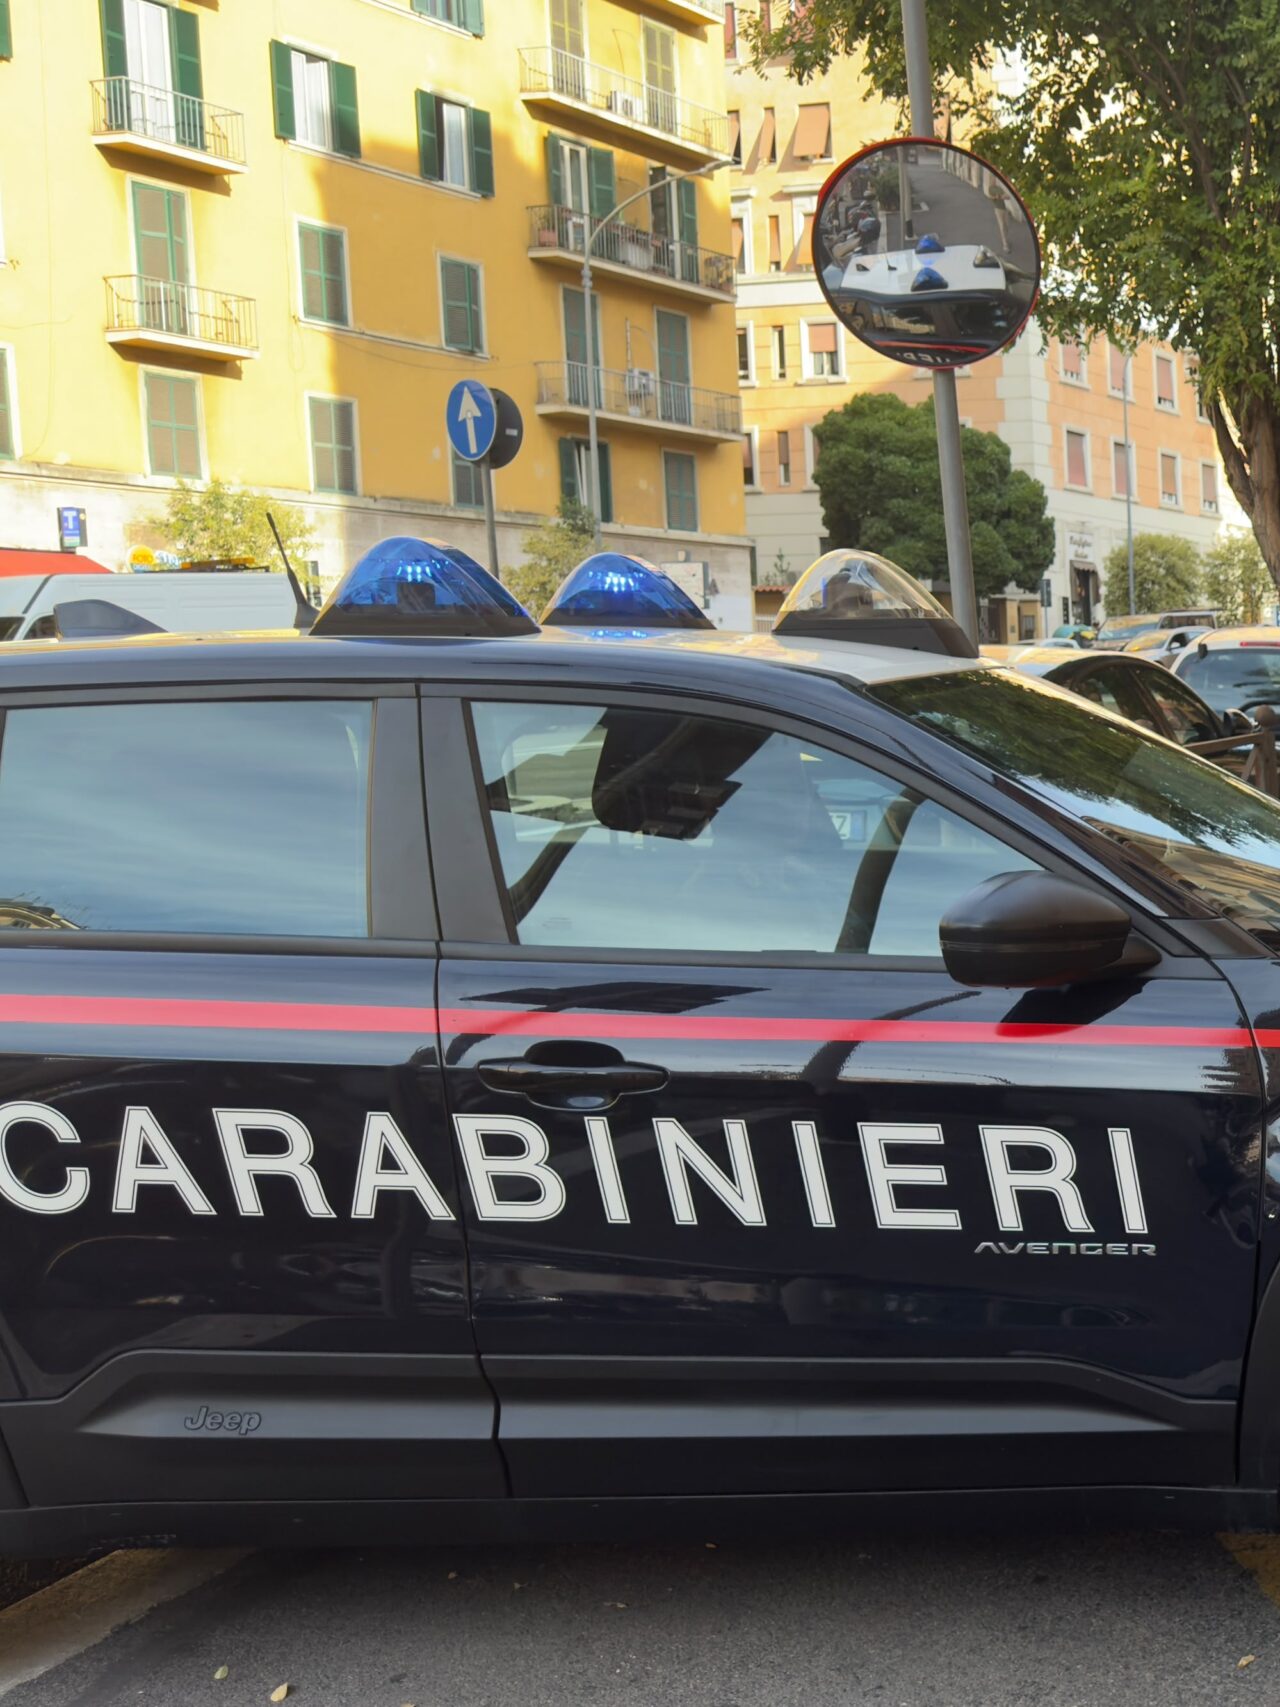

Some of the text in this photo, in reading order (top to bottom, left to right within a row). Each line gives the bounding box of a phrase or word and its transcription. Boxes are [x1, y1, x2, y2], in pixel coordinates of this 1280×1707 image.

[0, 1100, 1148, 1234] CARABINIERI
[974, 1241, 1157, 1256] AVENGER
[184, 1405, 261, 1435] Jeep
